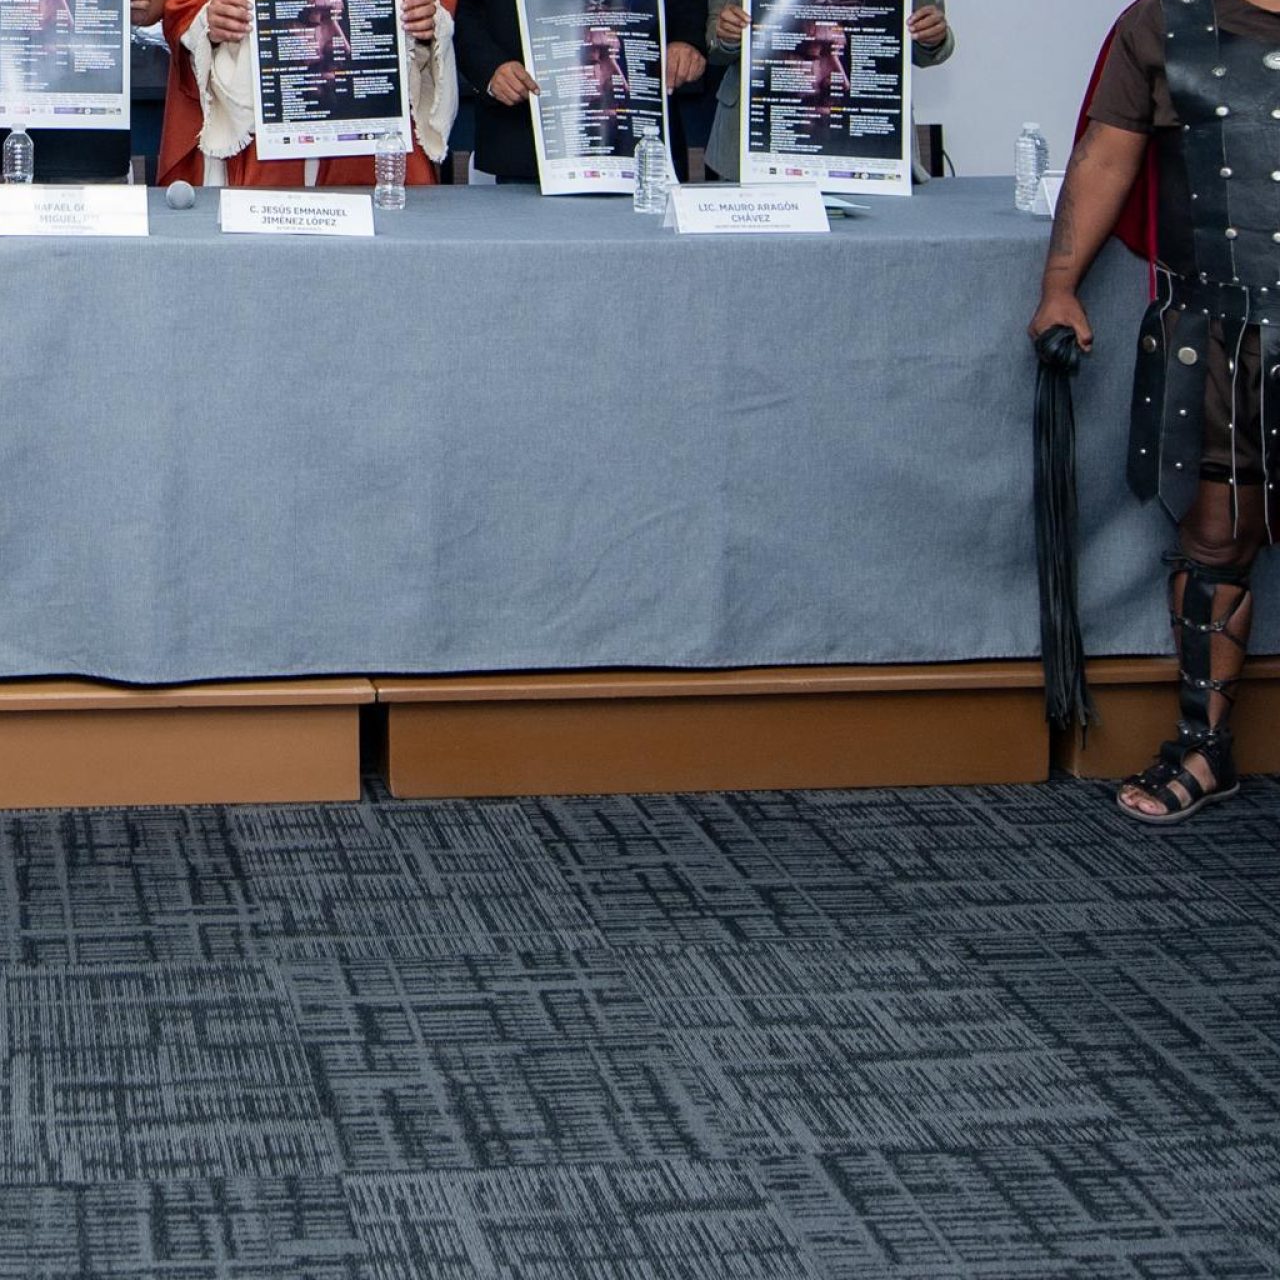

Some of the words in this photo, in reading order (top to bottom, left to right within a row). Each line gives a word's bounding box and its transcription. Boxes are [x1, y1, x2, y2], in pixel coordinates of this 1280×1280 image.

[249, 205, 259, 214] C.
[261, 204, 292, 215] JESÚS
[293, 207, 348, 217] EMMANUEL
[719, 203, 755, 212] MAURO
[757, 201, 799, 211] ARAGÓN
[261, 215, 304, 226] JIMÉNEZ
[306, 216, 337, 227] LÓPEZ
[731, 212, 771, 222] CHÁVEZ
